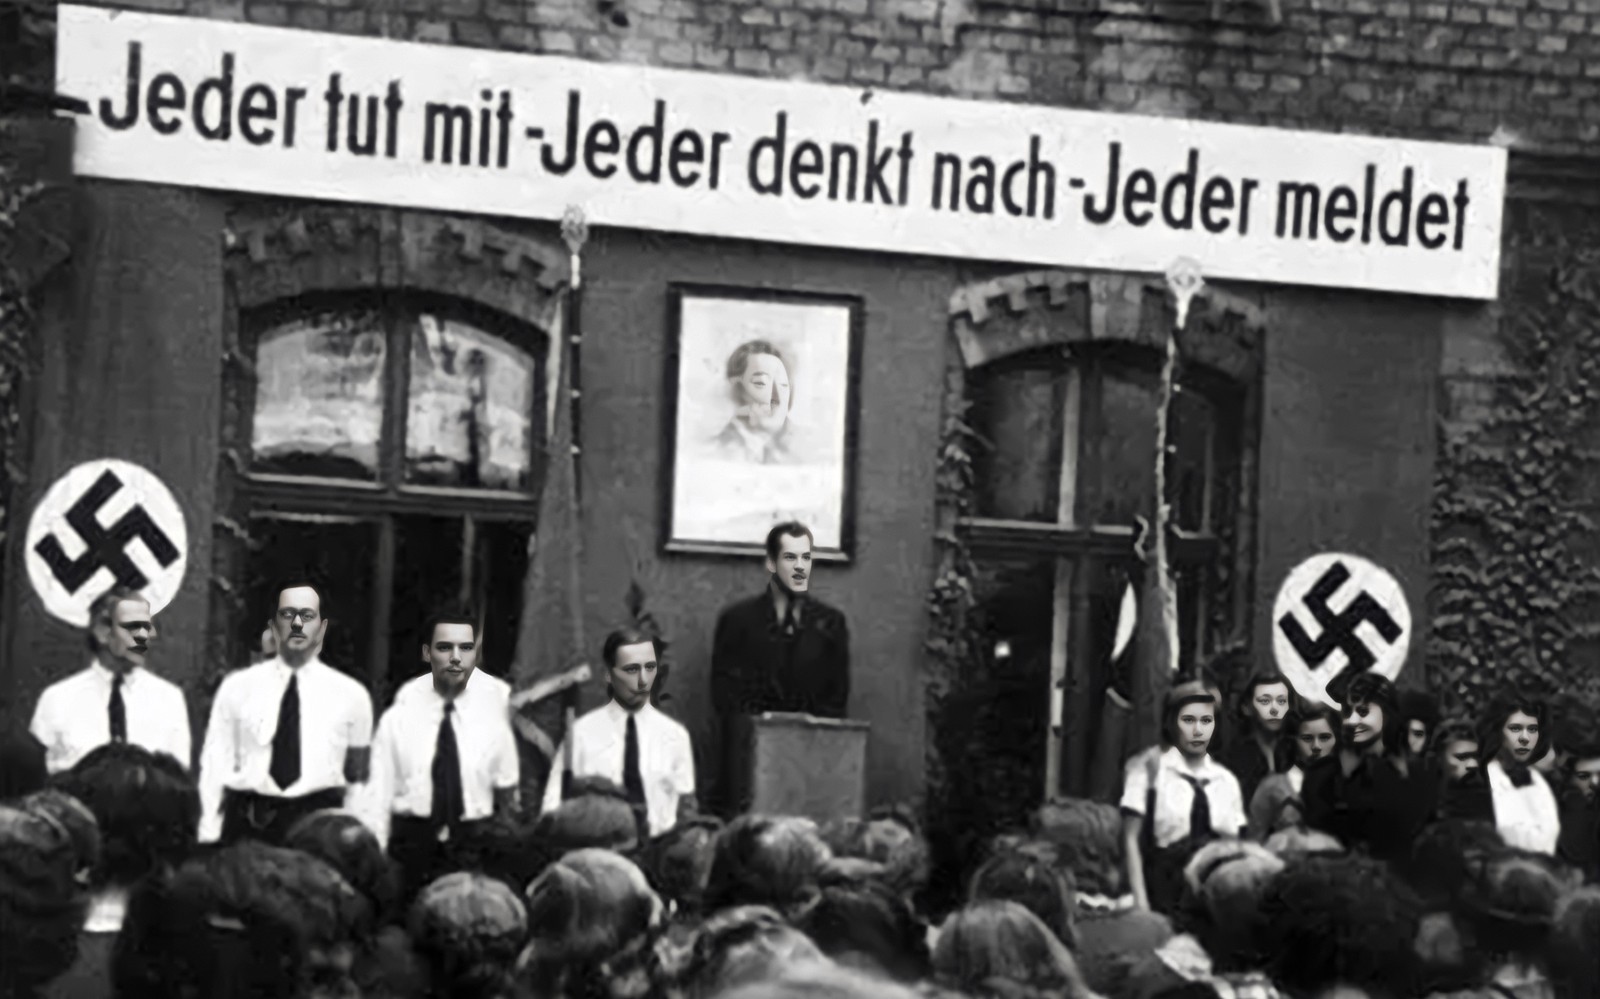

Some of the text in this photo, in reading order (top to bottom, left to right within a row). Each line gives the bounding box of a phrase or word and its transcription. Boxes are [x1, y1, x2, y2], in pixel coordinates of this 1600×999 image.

[98, 41, 307, 148] Jeder
[324, 72, 404, 159] tut
[423, 89, 514, 169] mit
[747, 111, 914, 206] denkt
[931, 134, 1056, 220] nach
[1275, 163, 1470, 251] meldet
